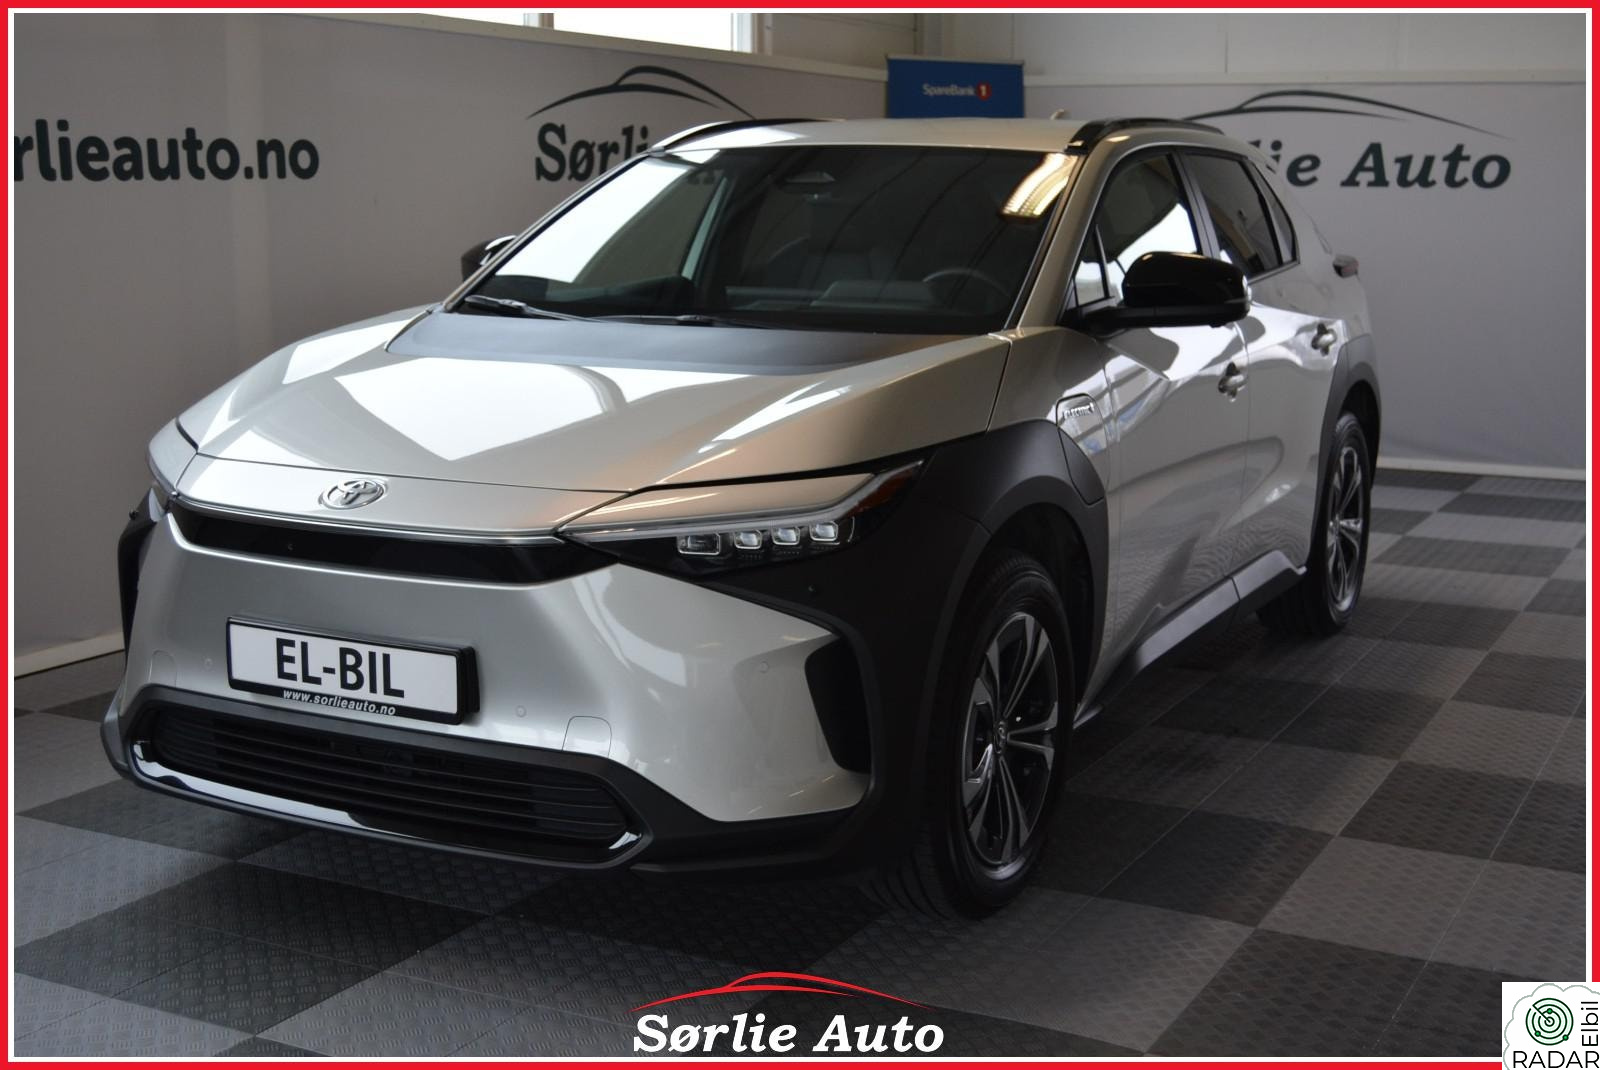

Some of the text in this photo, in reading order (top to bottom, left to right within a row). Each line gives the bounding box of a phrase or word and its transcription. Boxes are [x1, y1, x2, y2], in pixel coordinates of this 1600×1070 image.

[922, 83, 975, 98] SpareBank
[1340, 142, 1512, 189] Auto
[276, 637, 405, 699] EL-BIL
[283, 689, 396, 716] www.sorlieauto.no
